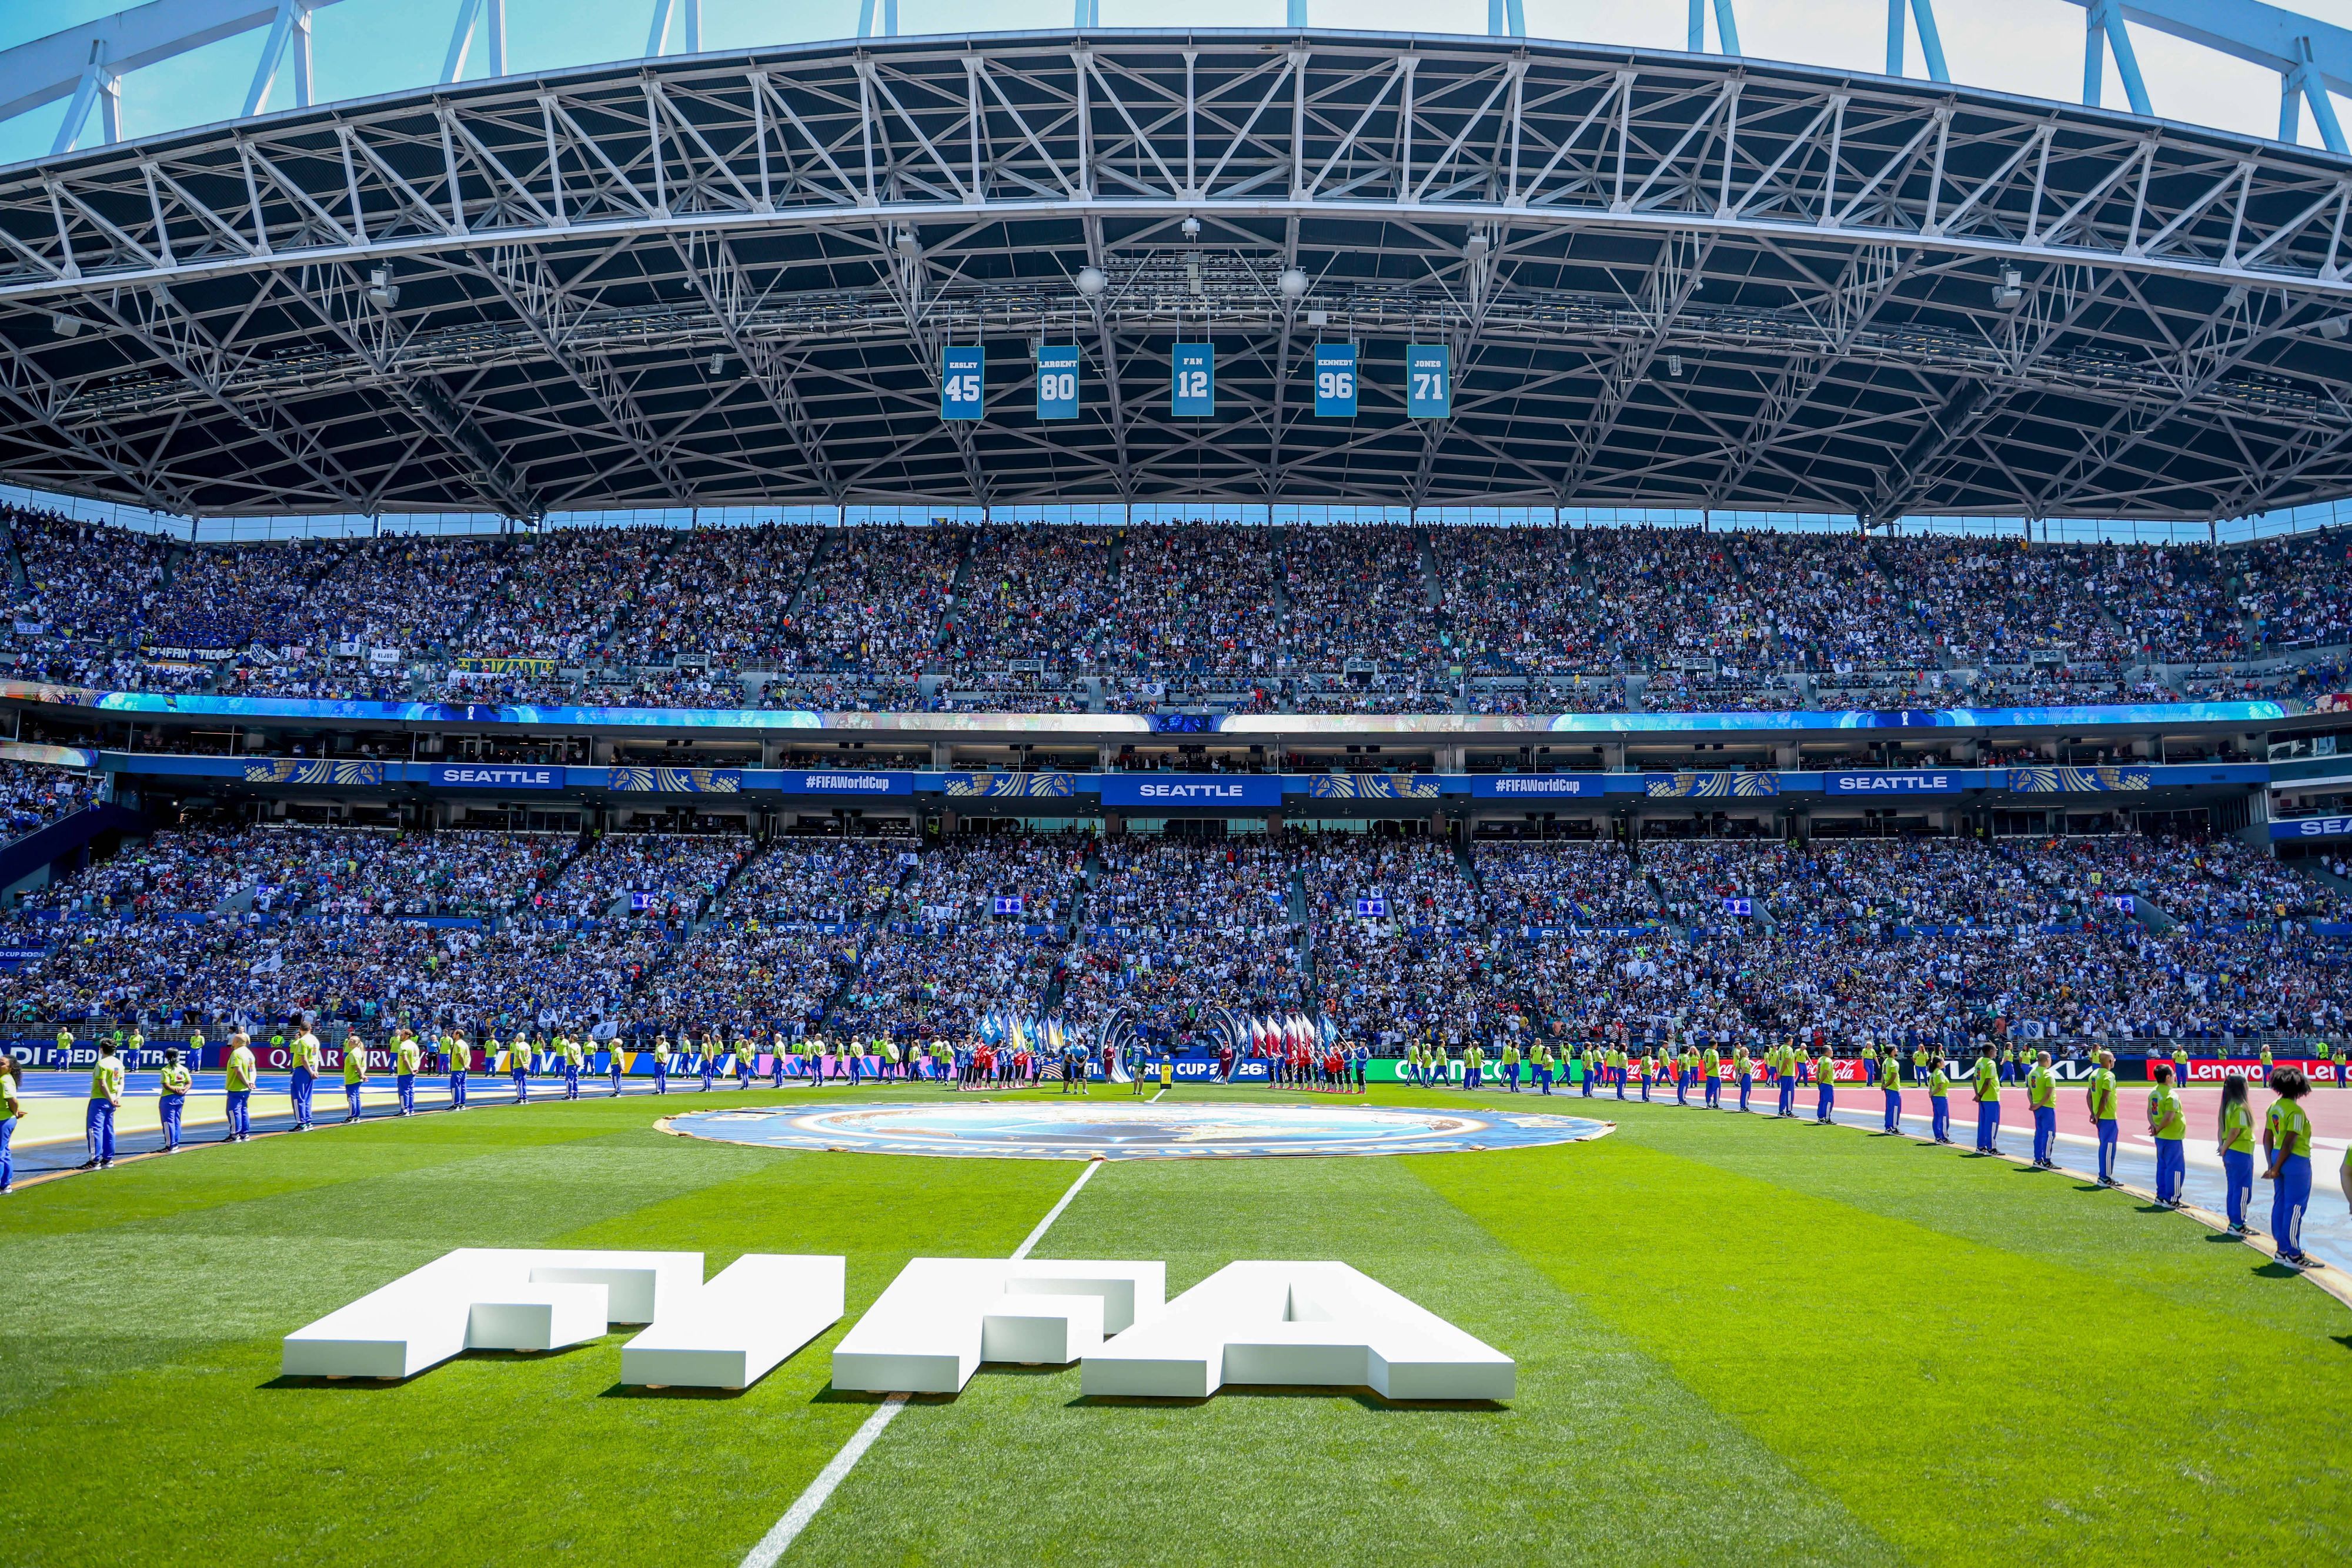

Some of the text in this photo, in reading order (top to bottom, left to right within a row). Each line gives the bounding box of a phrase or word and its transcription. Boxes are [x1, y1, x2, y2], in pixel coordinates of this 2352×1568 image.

[944, 376, 980, 401] 45
[1041, 374, 1074, 400] 80
[1179, 372, 1207, 397] 12
[1319, 373, 1352, 398] 96
[1414, 374, 1442, 399] 71
[443, 770, 550, 783] SEATTLE
[806, 775, 889, 791] #FIFAWorldCup
[1840, 777, 1947, 790] SEATTLE
[1140, 785, 1242, 796] SEATTLE
[1495, 779, 1579, 794] #FIFAWorldCup
[1176, 1063, 1207, 1075] CUP
[1209, 1063, 1262, 1075] 226
[879, 1143, 1106, 1155] WORLD
[283, 1248, 1515, 1400] FIFA
